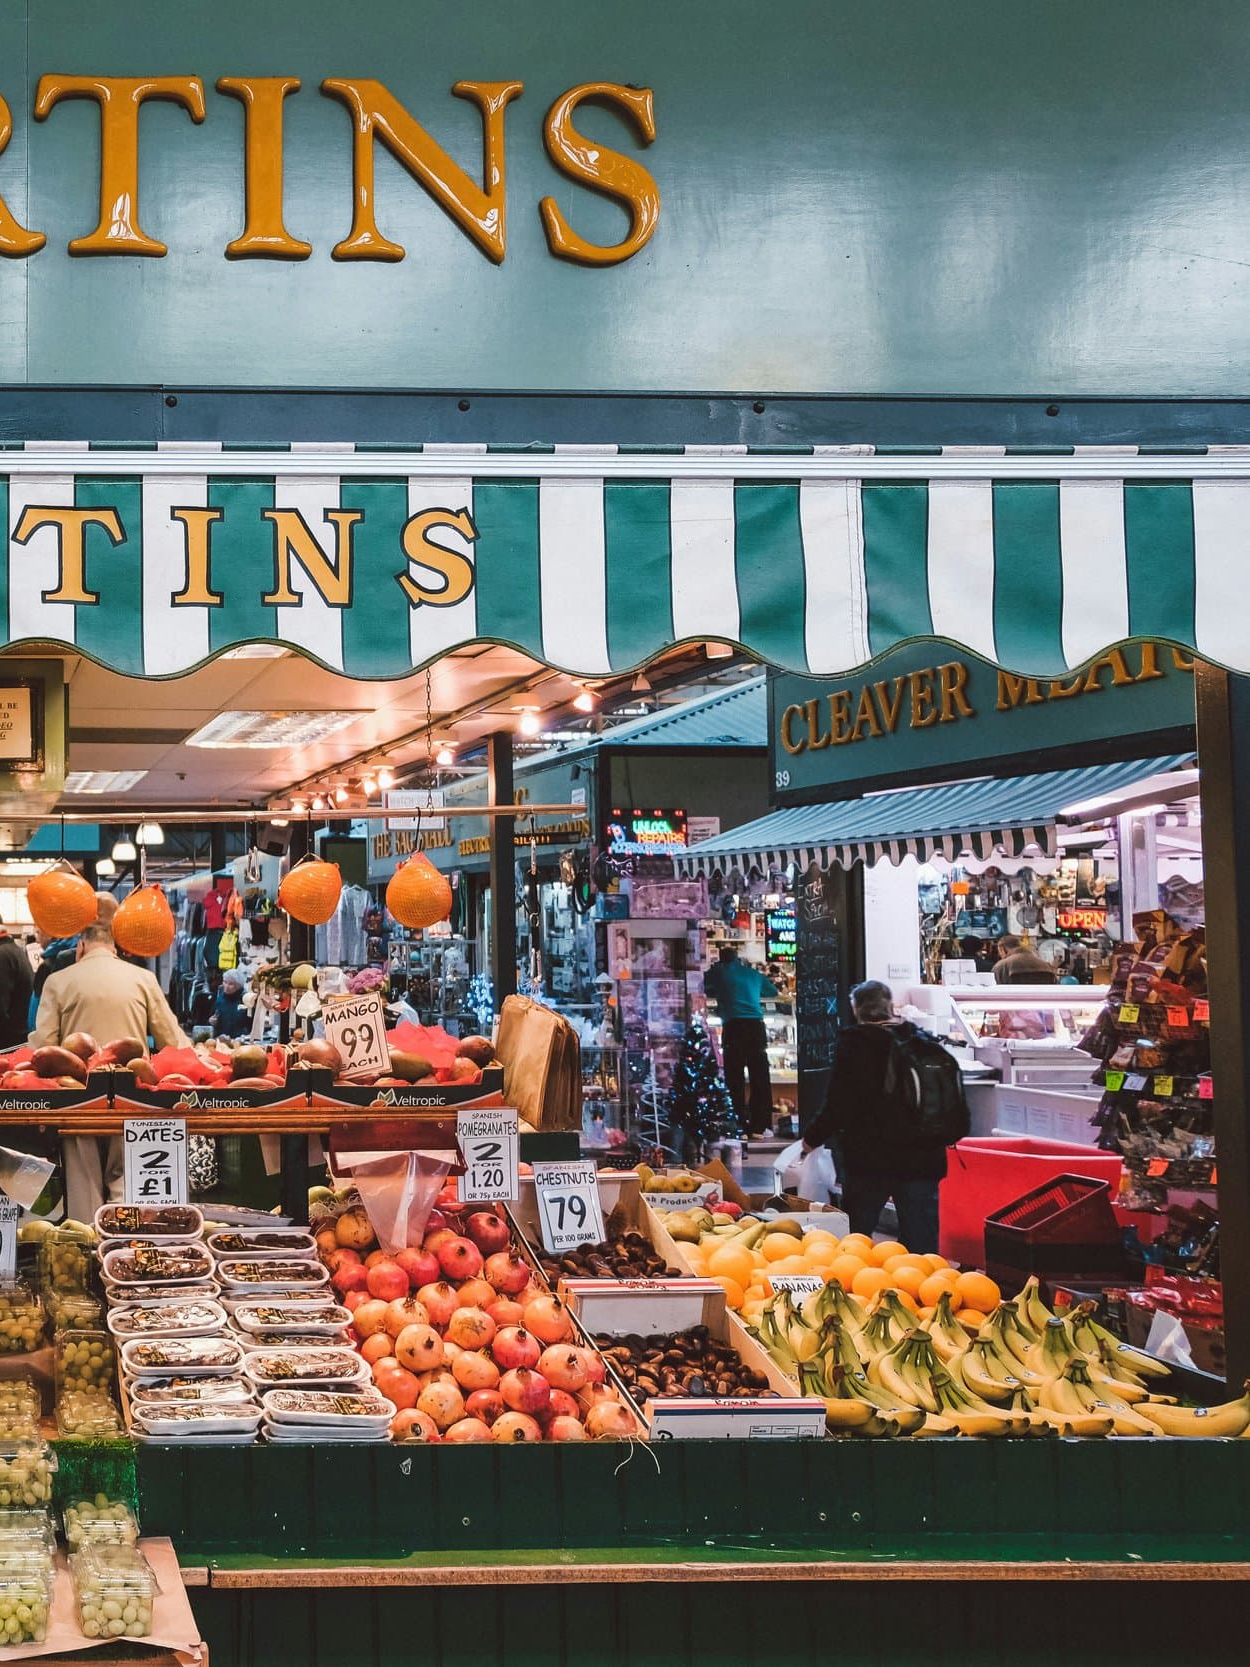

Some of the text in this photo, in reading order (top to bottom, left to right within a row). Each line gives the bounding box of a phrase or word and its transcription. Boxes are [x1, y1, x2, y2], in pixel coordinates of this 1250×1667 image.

[7, 702, 18, 710] BE
[780, 661, 973, 756] CLEAVER
[776, 771, 790, 788] 39
[372, 831, 391, 859] THE
[638, 833, 685, 843] REPAIRS
[1060, 911, 1105, 928] OPEN
[325, 1002, 379, 1024] MANGO
[341, 1023, 374, 1058] 99
[196, 1097, 249, 1110] Veltropic
[392, 1094, 446, 1107] Veltropic
[125, 1128, 184, 1142] DATES
[458, 1121, 517, 1137] POMEGRANATES
[139, 1150, 172, 1169] 2
[471, 1142, 504, 1161] 2
[138, 1176, 172, 1196] £1
[471, 1168, 504, 1188] 1.20
[536, 1172, 595, 1185] CHESTNUTS
[661, 1196, 698, 1206] Produce
[549, 1195, 586, 1230] 79
[553, 1232, 596, 1243] PER 100 GRAMS
